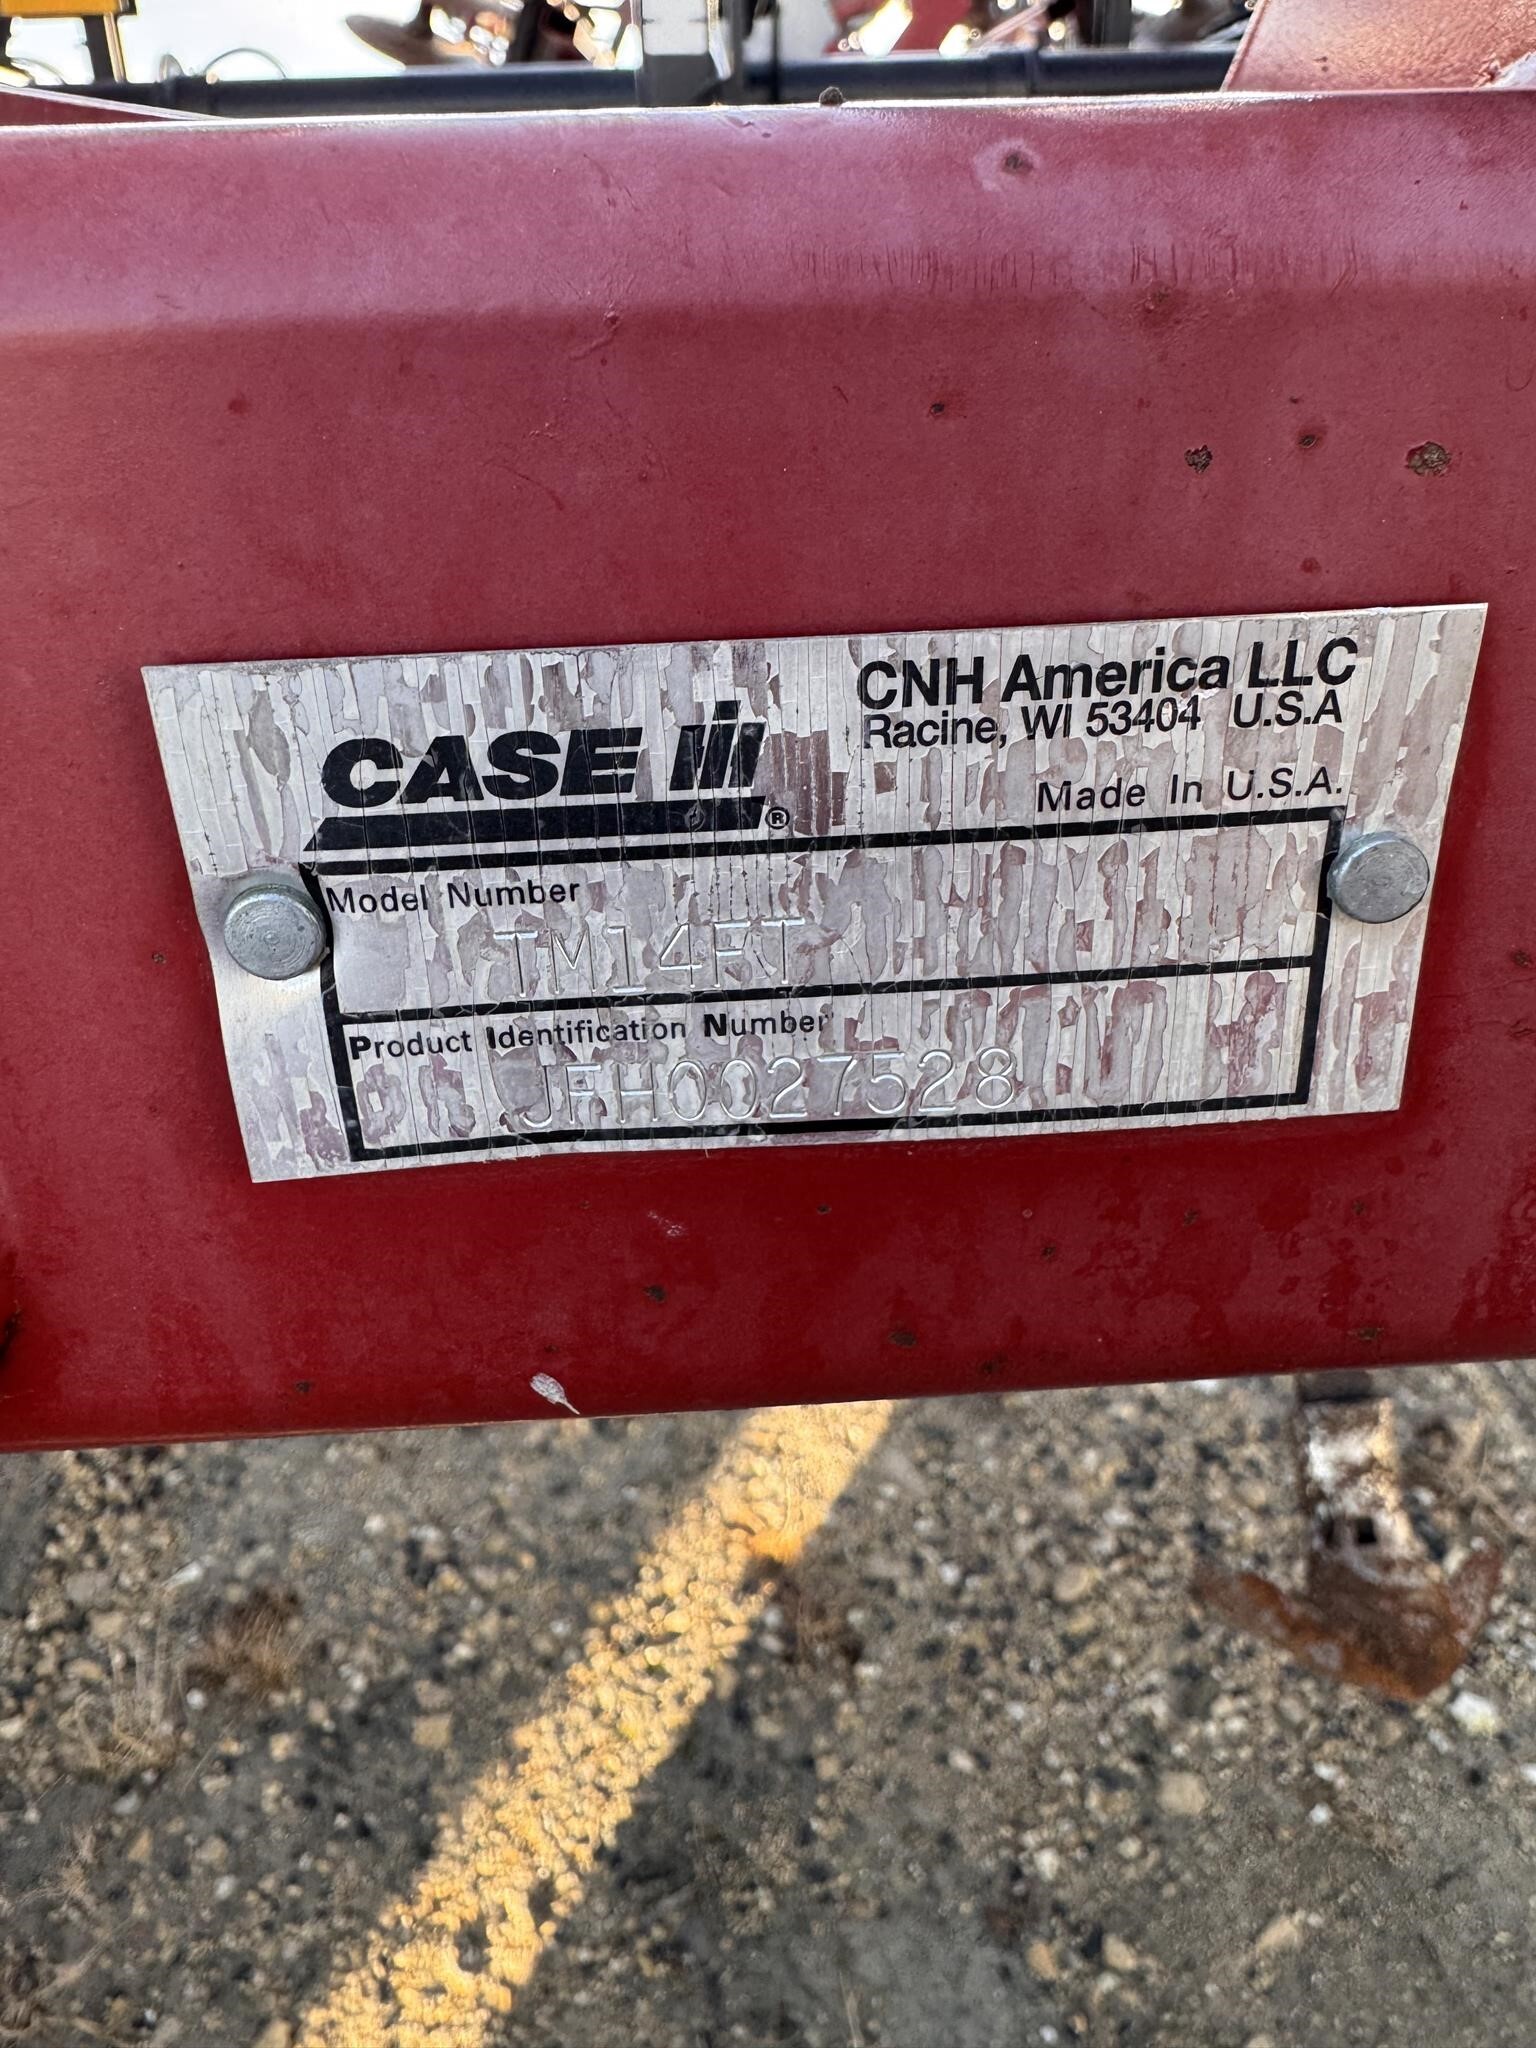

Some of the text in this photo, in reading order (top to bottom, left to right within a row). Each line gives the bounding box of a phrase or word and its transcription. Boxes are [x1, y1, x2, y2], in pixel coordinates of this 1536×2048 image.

[858, 637, 1358, 710] CNH America LLC
[863, 690, 1343, 749] Racine, WI 53404 U.S.A
[321, 727, 643, 808] CASE
[1037, 767, 1343, 812] Made In U.S.A.
[325, 879, 581, 914] Model Number
[493, 918, 807, 998] TM14FT
[349, 1010, 835, 1060] Product Identification Number
[521, 1045, 1018, 1129] JFH0027528
